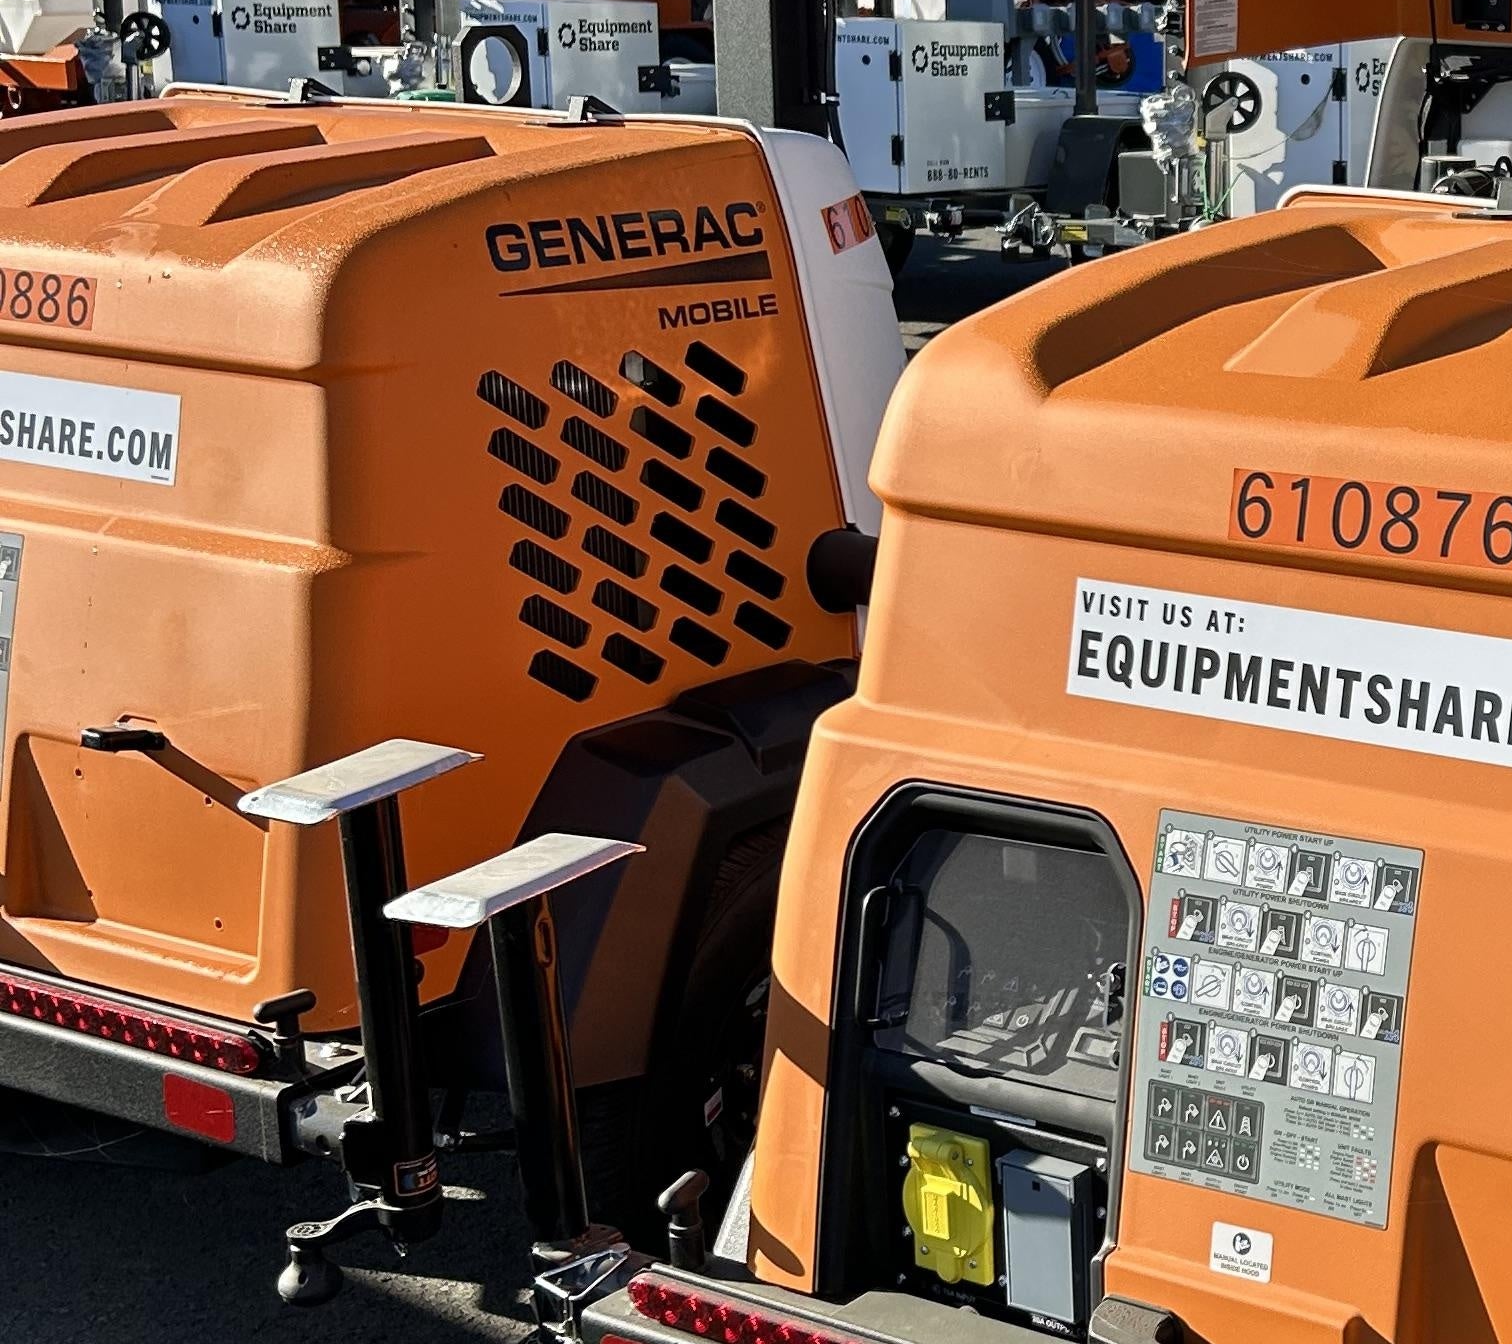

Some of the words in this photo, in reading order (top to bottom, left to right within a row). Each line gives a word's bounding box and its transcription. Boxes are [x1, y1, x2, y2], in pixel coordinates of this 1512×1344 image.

[253, 3, 333, 21] Equipment
[254, 20, 297, 34] Share
[578, 18, 652, 35] Equipment
[578, 37, 620, 52] Share
[931, 41, 1000, 61] Equipment
[931, 62, 968, 77] Share
[485, 202, 763, 272] GENERAC
[658, 294, 779, 330] MOBILE
[0, 409, 173, 471] SHARE.COM
[1081, 591, 1150, 622] VISIT
[1161, 603, 1193, 629] US
[1206, 611, 1246, 635] AT:
[1244, 826, 1271, 837] UTILITY
[1271, 830, 1299, 841] POWER
[1299, 834, 1323, 845] START
[1323, 838, 1334, 846] UP
[1232, 888, 1259, 898] UTILITY
[1260, 893, 1287, 903] POWER
[1288, 898, 1330, 910] SHUTDOWN
[1280, 959, 1307, 971] POWER
[1307, 964, 1332, 975] START
[1332, 968, 1343, 977] UP
[1270, 1021, 1297, 1033] POWER
[1298, 1027, 1340, 1042] SHUTDOWN
[1213, 1252, 1239, 1264] MANUAL
[1239, 1258, 1269, 1271] LOCATED
[1220, 1262, 1241, 1273] INSIDE
